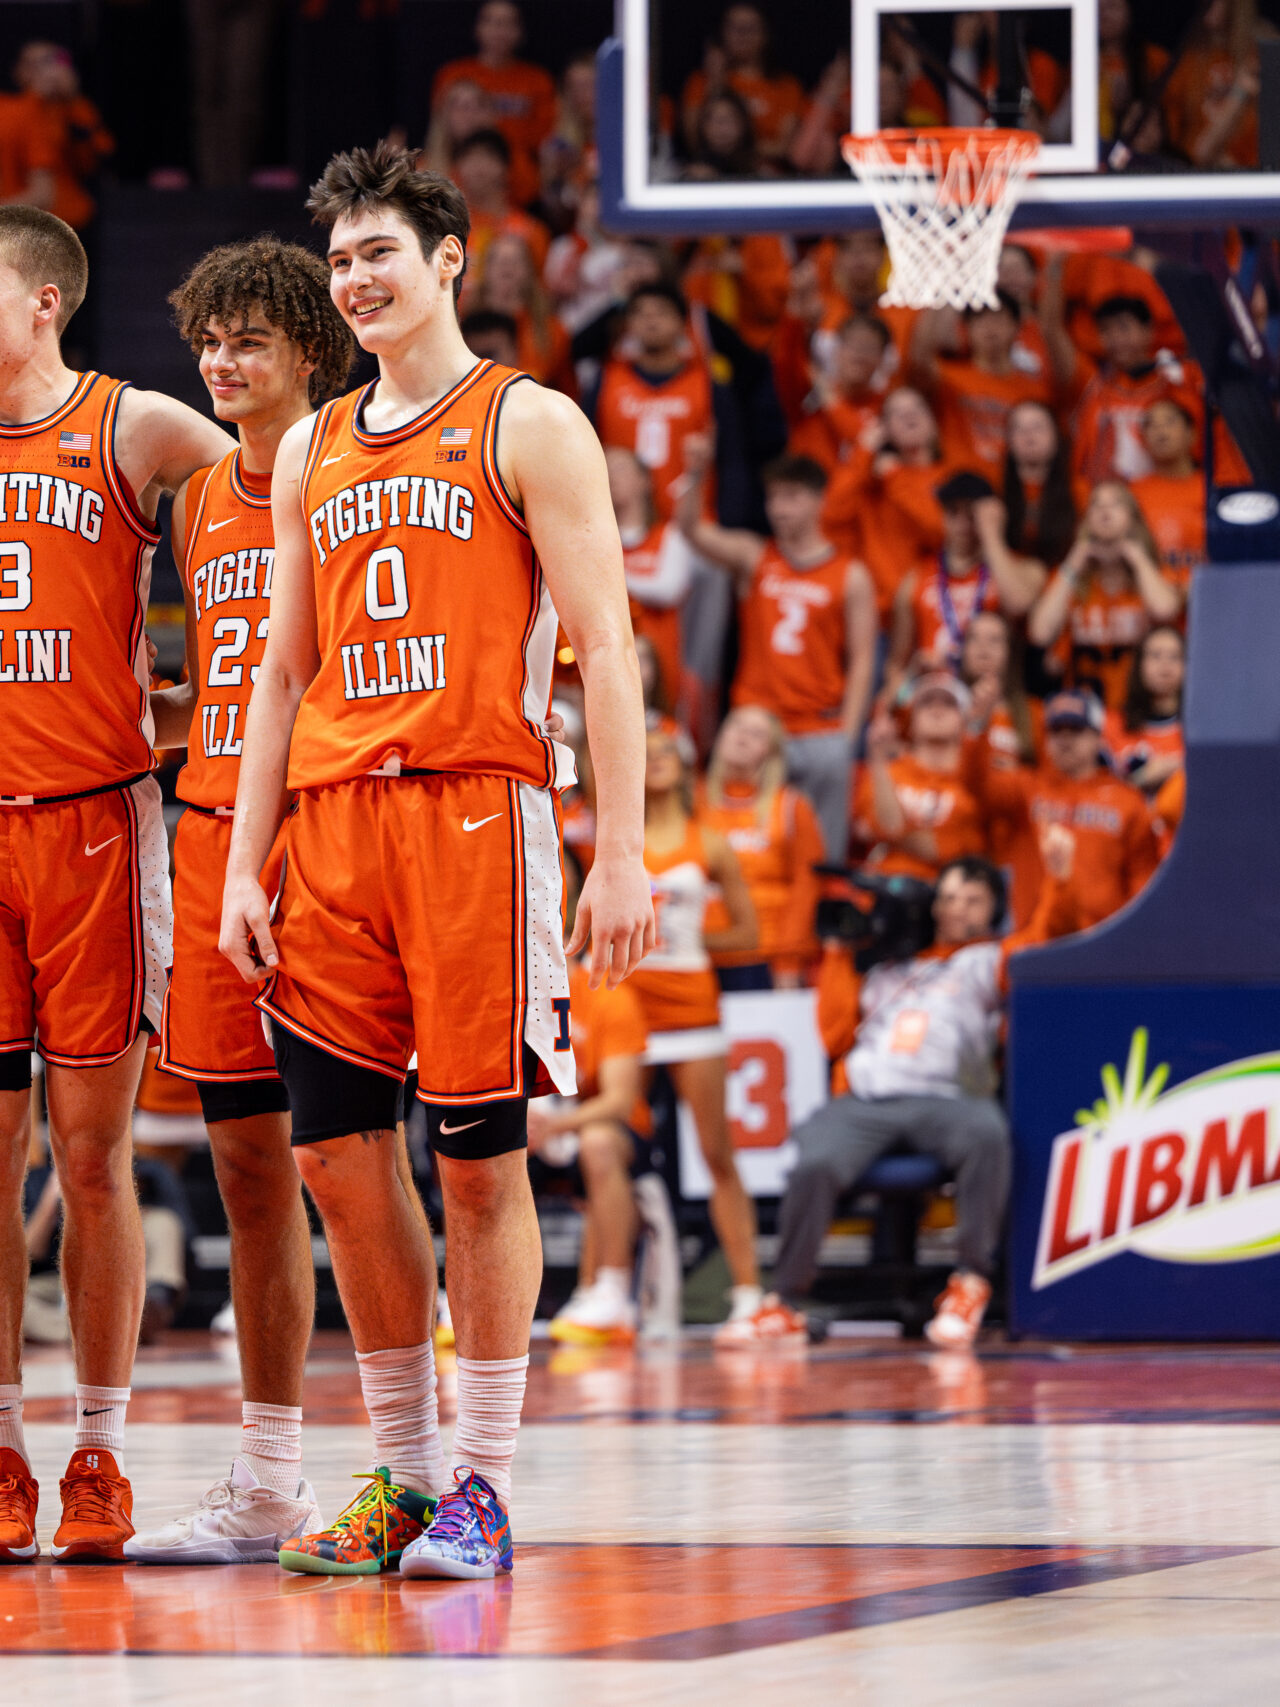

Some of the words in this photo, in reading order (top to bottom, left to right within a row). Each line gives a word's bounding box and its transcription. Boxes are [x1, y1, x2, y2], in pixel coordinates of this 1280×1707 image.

[309, 475, 475, 567] FIGHTING
[193, 547, 275, 624] FIGHT
[364, 545, 410, 621] 0
[771, 598, 808, 655] 2
[340, 634, 447, 700] ILLINI
[202, 703, 250, 759] ILL
[551, 997, 572, 1052] I
[726, 1038, 788, 1149] 3
[1046, 1107, 1280, 1265] LIBM
